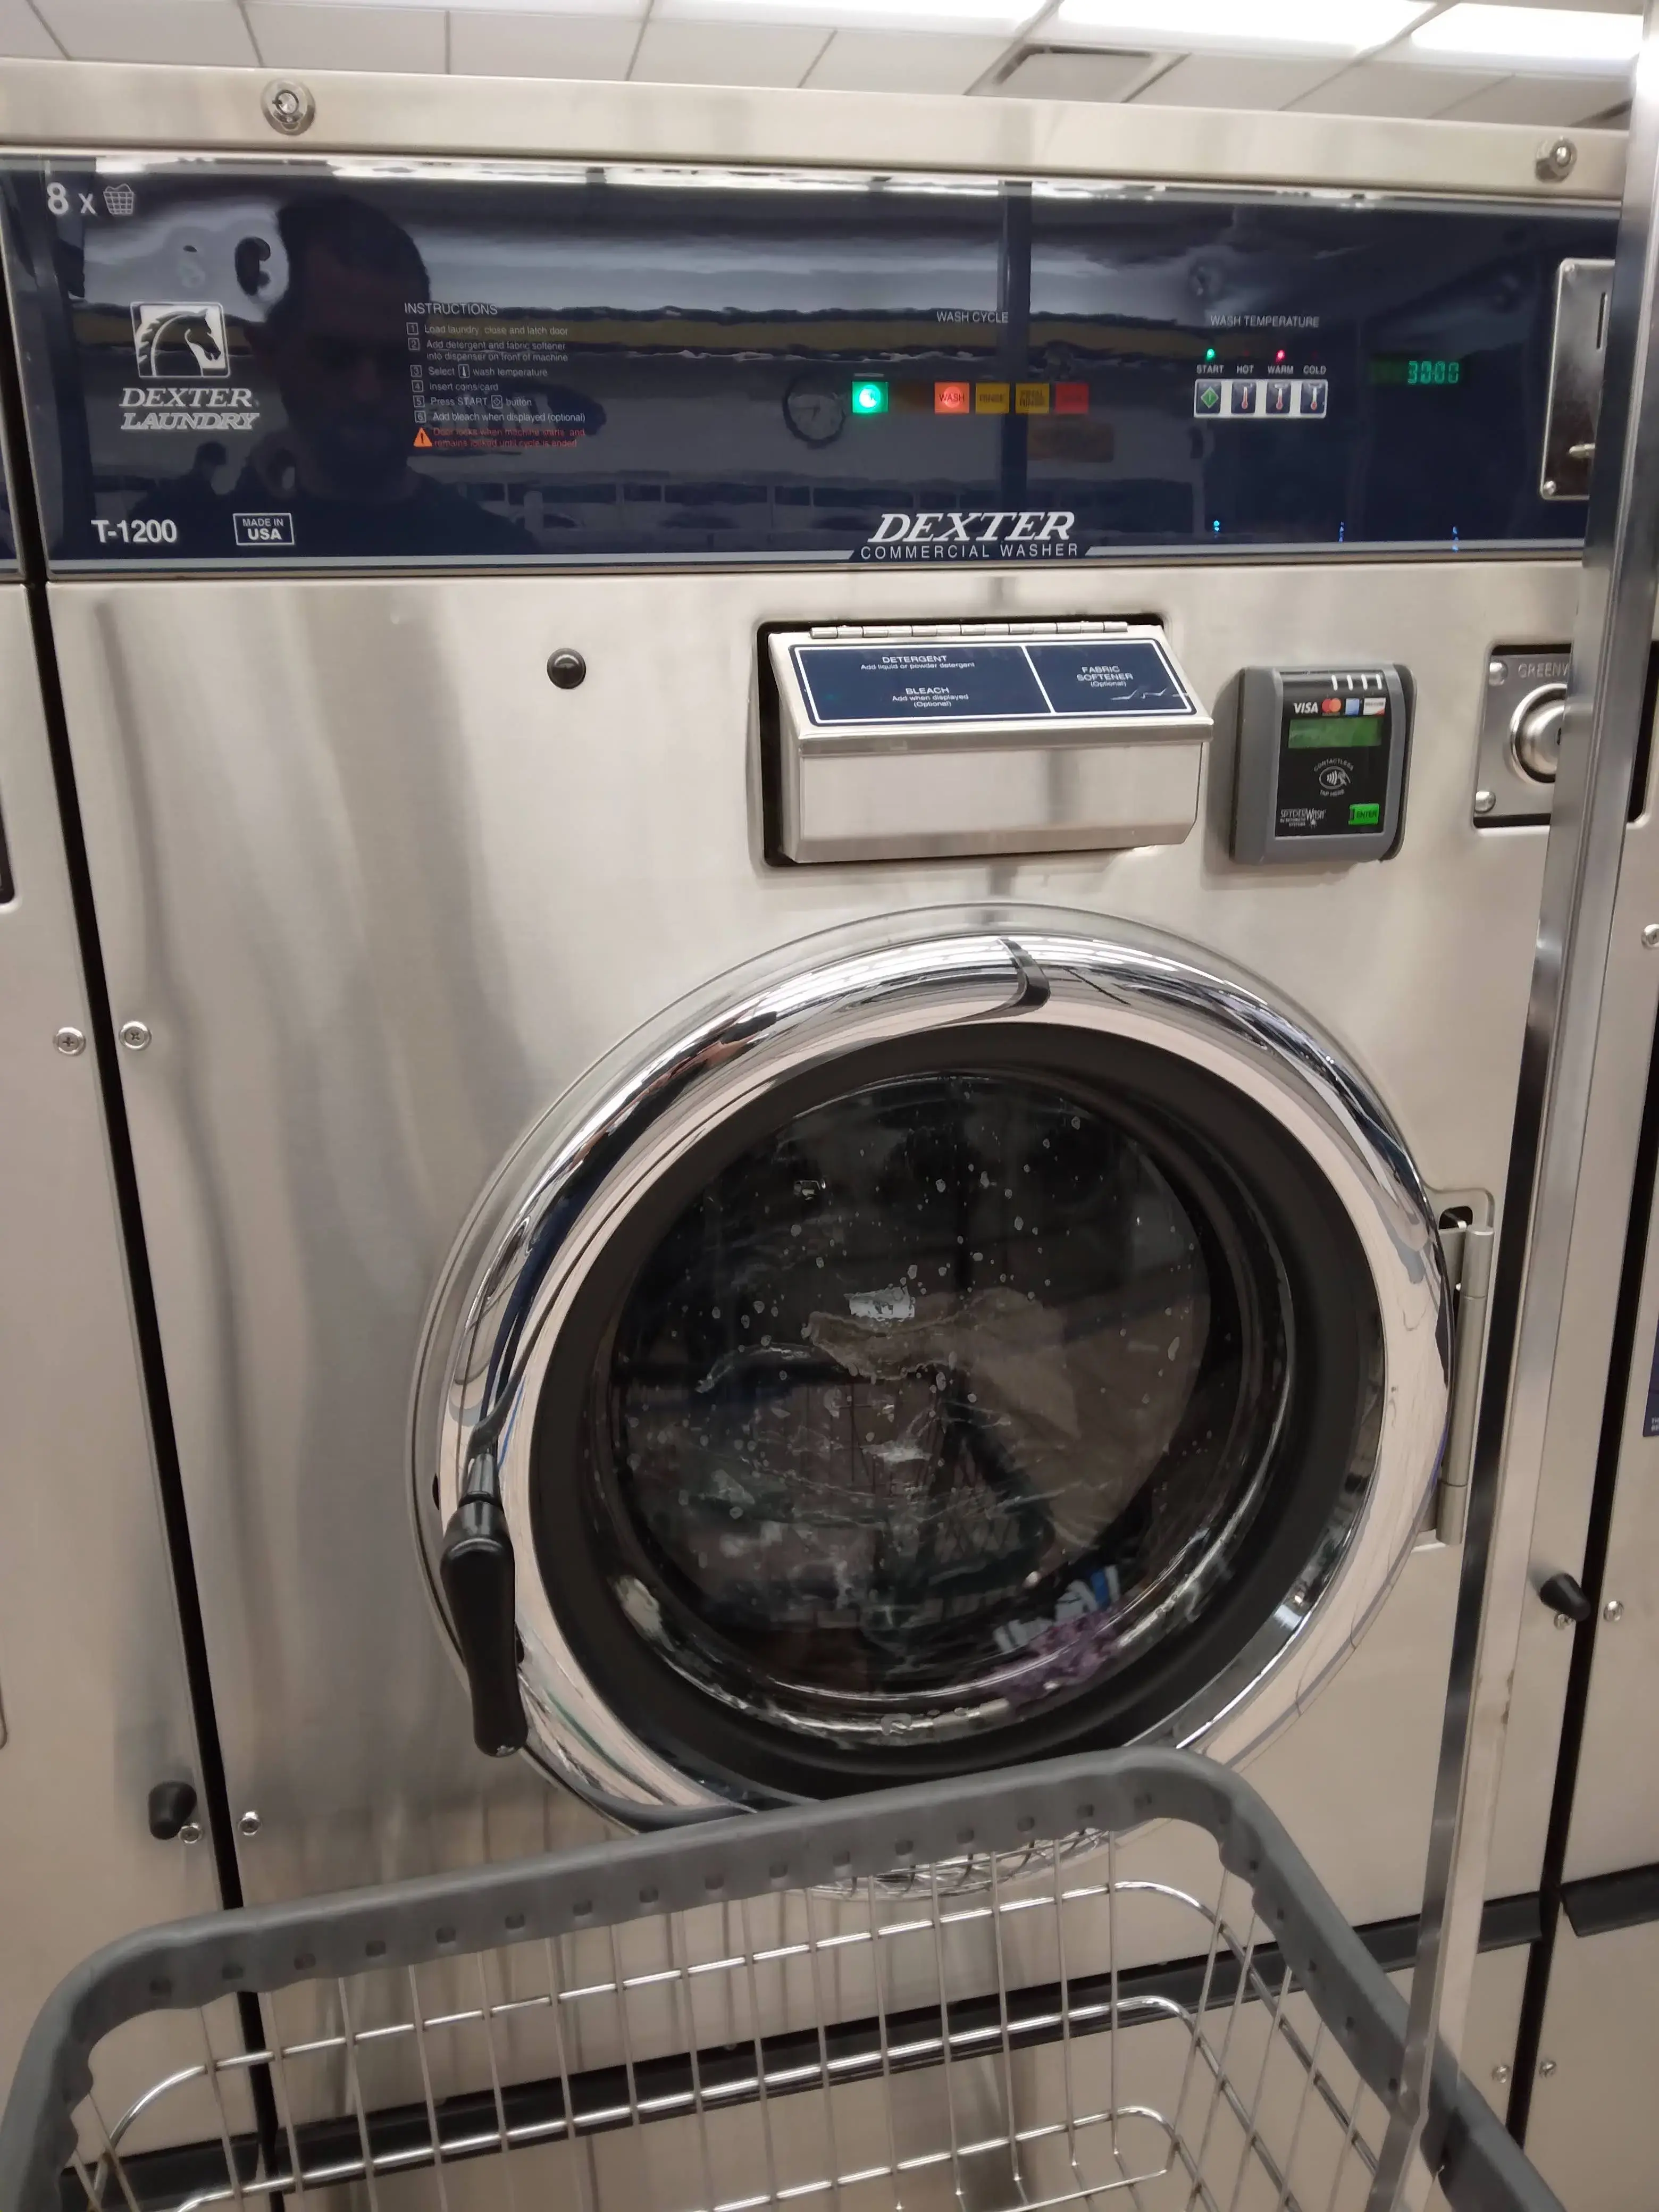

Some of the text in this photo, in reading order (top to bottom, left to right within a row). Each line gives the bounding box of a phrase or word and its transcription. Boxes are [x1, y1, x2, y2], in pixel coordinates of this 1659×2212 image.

[47, 182, 69, 215] 8
[404, 302, 498, 315] INSTRUCTIONS
[936, 311, 1009, 323] WASH CYCLE
[1210, 315, 1320, 328] WASH TEMPERATURE
[424, 324, 446, 334] Load
[484, 325, 507, 335] close
[509, 326, 525, 335] and
[527, 325, 547, 336] latch
[426, 340, 443, 349] Add
[446, 340, 486, 352] detergent
[506, 341, 530, 350] fabric
[532, 341, 566, 350] softener
[445, 353, 486, 363] dispenser
[501, 353, 521, 361] front
[522, 353, 532, 362] of
[533, 353, 568, 362] machine
[428, 367, 455, 376] Select
[472, 368, 548, 378] wash temperature
[1196, 364, 1327, 375] START HOT WARM COLD
[430, 382, 453, 391] Insert
[119, 388, 253, 407] DEXTER
[430, 397, 455, 406] Press
[457, 397, 488, 406] START
[939, 393, 965, 403] WASH
[120, 412, 260, 430] LAUNDRY
[433, 412, 450, 421] Add
[452, 412, 480, 421] bleach
[507, 413, 546, 423] displayed
[548, 413, 586, 424] (optional)
[242, 517, 284, 527] MADE IN
[867, 510, 1075, 543] DEXTER
[90, 519, 178, 543] T-1200
[247, 528, 282, 541] USA
[860, 543, 1078, 560] COMMERCIAL WASHER
[882, 655, 947, 664] DETERGENT
[1081, 665, 1120, 674] FABRIC
[1076, 673, 1134, 682] SOFTENER
[906, 686, 950, 695] BLEACH
[1293, 701, 1319, 714] VISA
[1313, 757, 1355, 772] CONTACTLESS
[1356, 810, 1377, 819] ENTER
